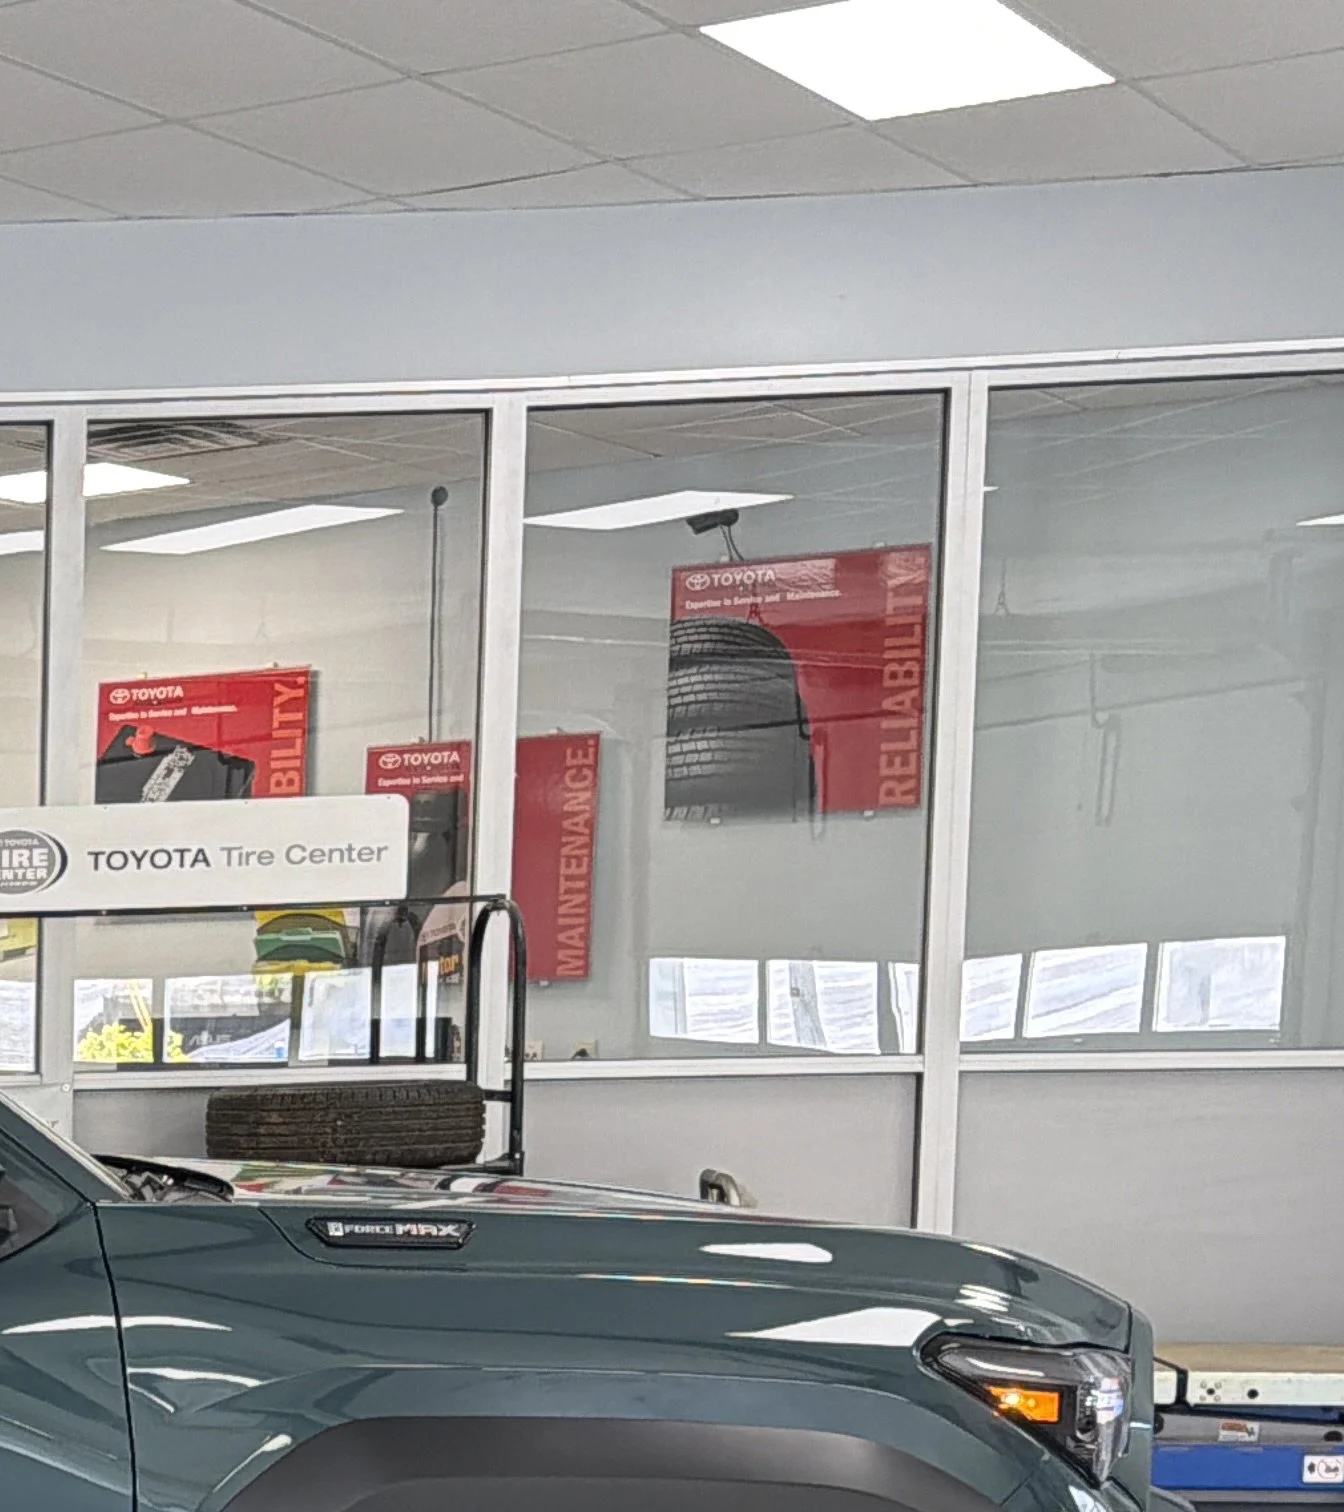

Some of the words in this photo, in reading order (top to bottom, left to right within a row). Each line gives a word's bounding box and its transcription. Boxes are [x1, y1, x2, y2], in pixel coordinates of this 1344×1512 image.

[712, 569, 776, 587] TOYOTA
[879, 555, 926, 805] RELIABILITY.
[130, 685, 184, 700] TOYOTA
[402, 750, 461, 766] TOYOTA
[4, 838, 40, 848] TOYOTA
[87, 847, 212, 871] TOYOTA
[219, 846, 275, 867] Tire
[284, 843, 389, 867] Center
[557, 738, 596, 977] MAINTENANCE.
